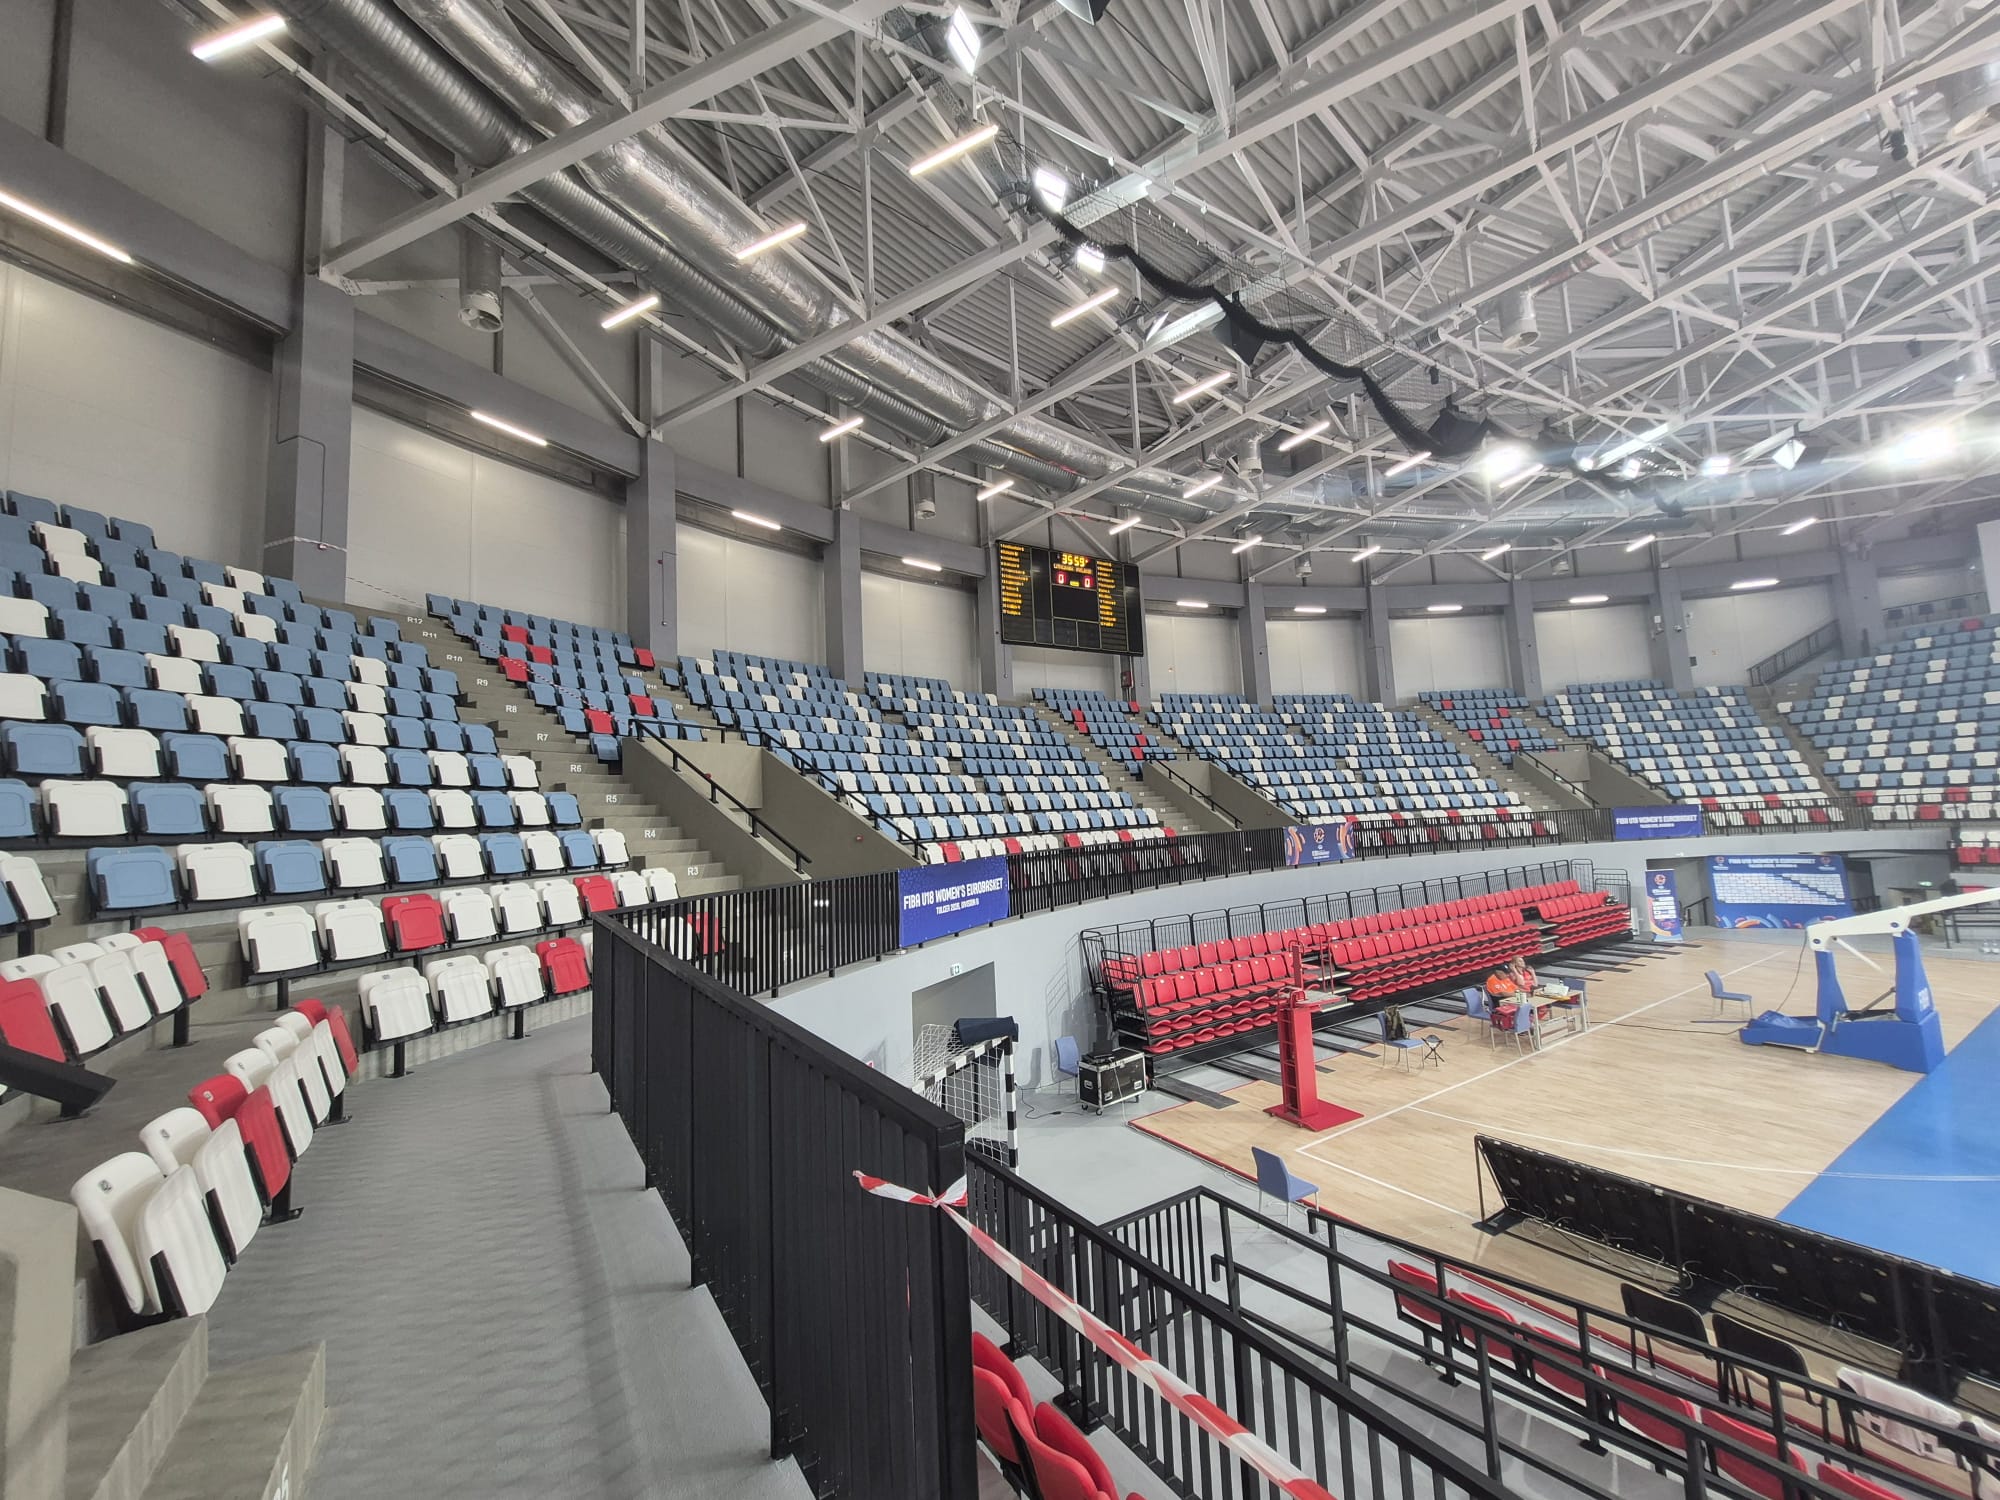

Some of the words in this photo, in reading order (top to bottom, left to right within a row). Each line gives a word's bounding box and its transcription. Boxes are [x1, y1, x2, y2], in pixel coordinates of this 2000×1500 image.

[422, 631, 437, 639] R11
[446, 654, 463, 662] R10
[476, 678, 489, 687] R9
[505, 704, 518, 713] R8
[536, 733, 549, 742] R7
[570, 764, 582, 773] R6
[605, 794, 618, 803] R5
[644, 829, 656, 838] R4
[687, 866, 699, 876] R3
[903, 893, 921, 910] FIBA
[921, 890, 934, 906] U18
[935, 884, 966, 904] WOMEN'S
[966, 877, 1004, 896] EUROBASKET
